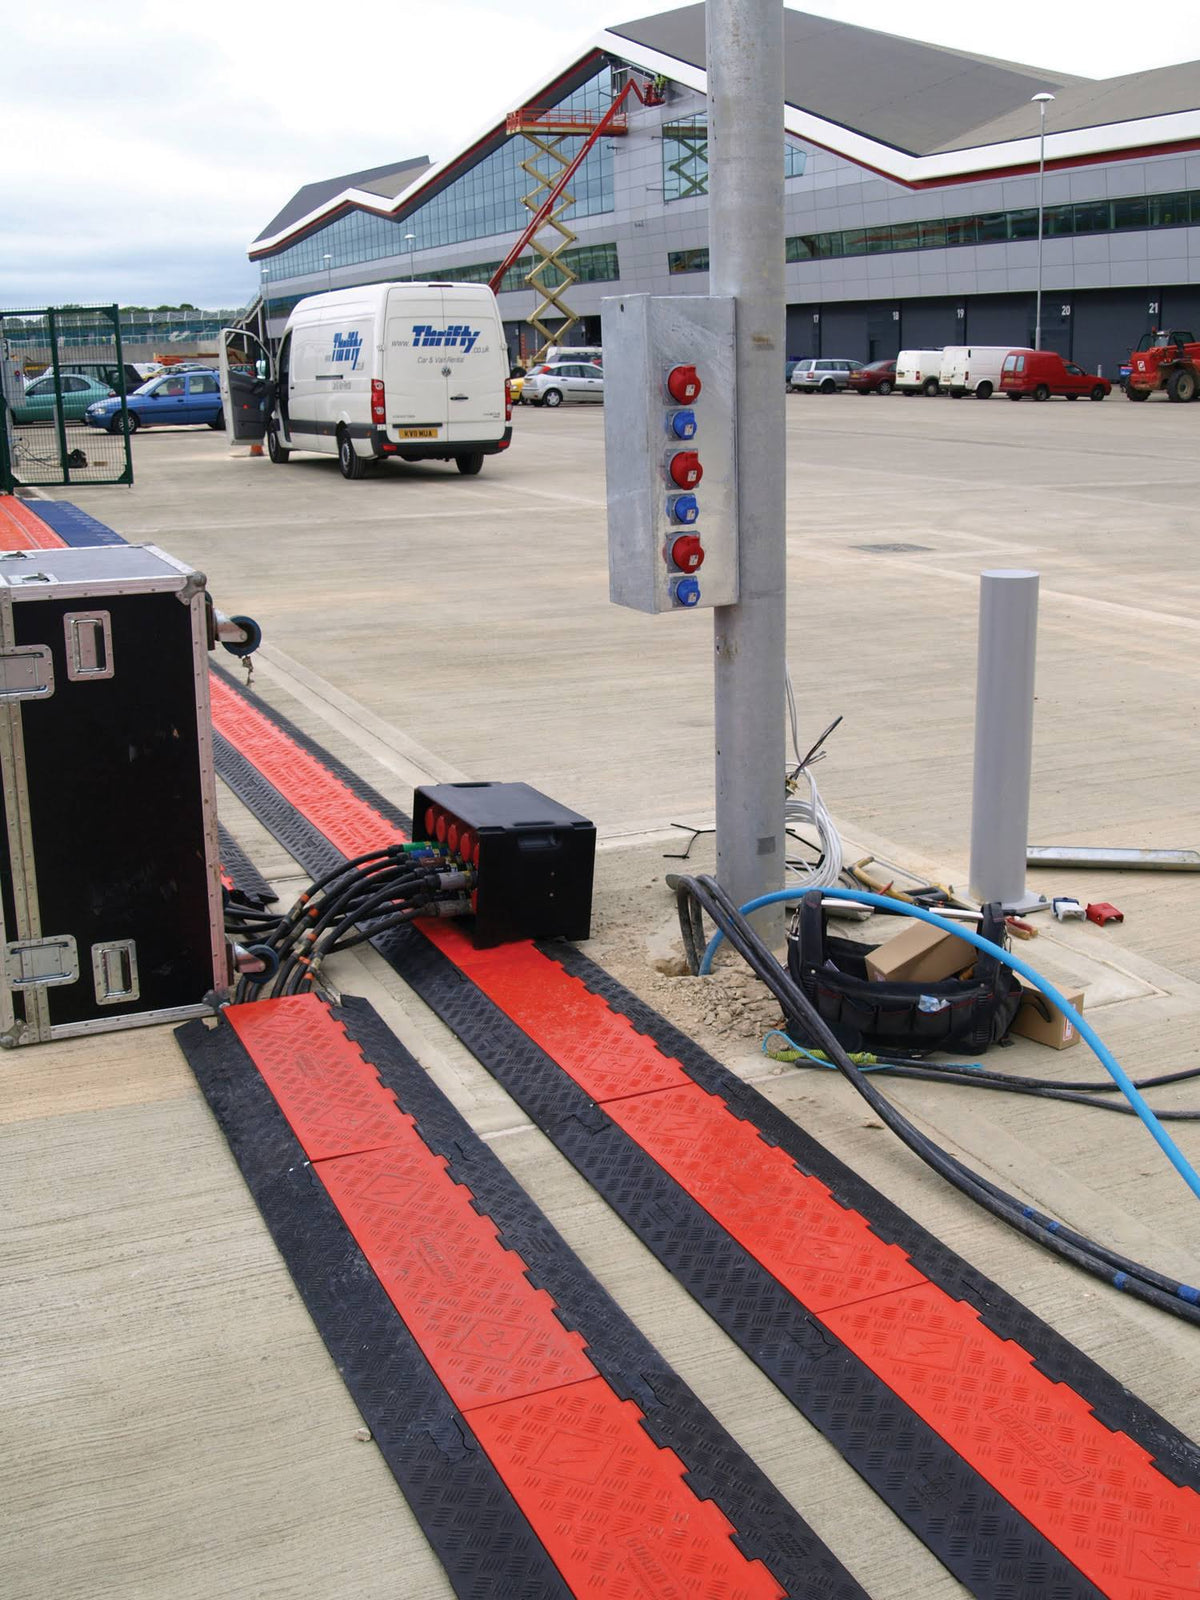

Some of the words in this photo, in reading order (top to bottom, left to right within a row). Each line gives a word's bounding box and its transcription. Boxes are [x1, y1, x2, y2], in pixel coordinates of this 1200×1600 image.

[1061, 305, 1071, 315] 20
[1149, 303, 1159, 313] 21
[813, 314, 819, 323] 17
[957, 308, 964, 319] 19
[412, 325, 481, 353] Thrifty
[998, 1412, 1046, 1451] GUARD
[1042, 1452, 1077, 1479] DOG
